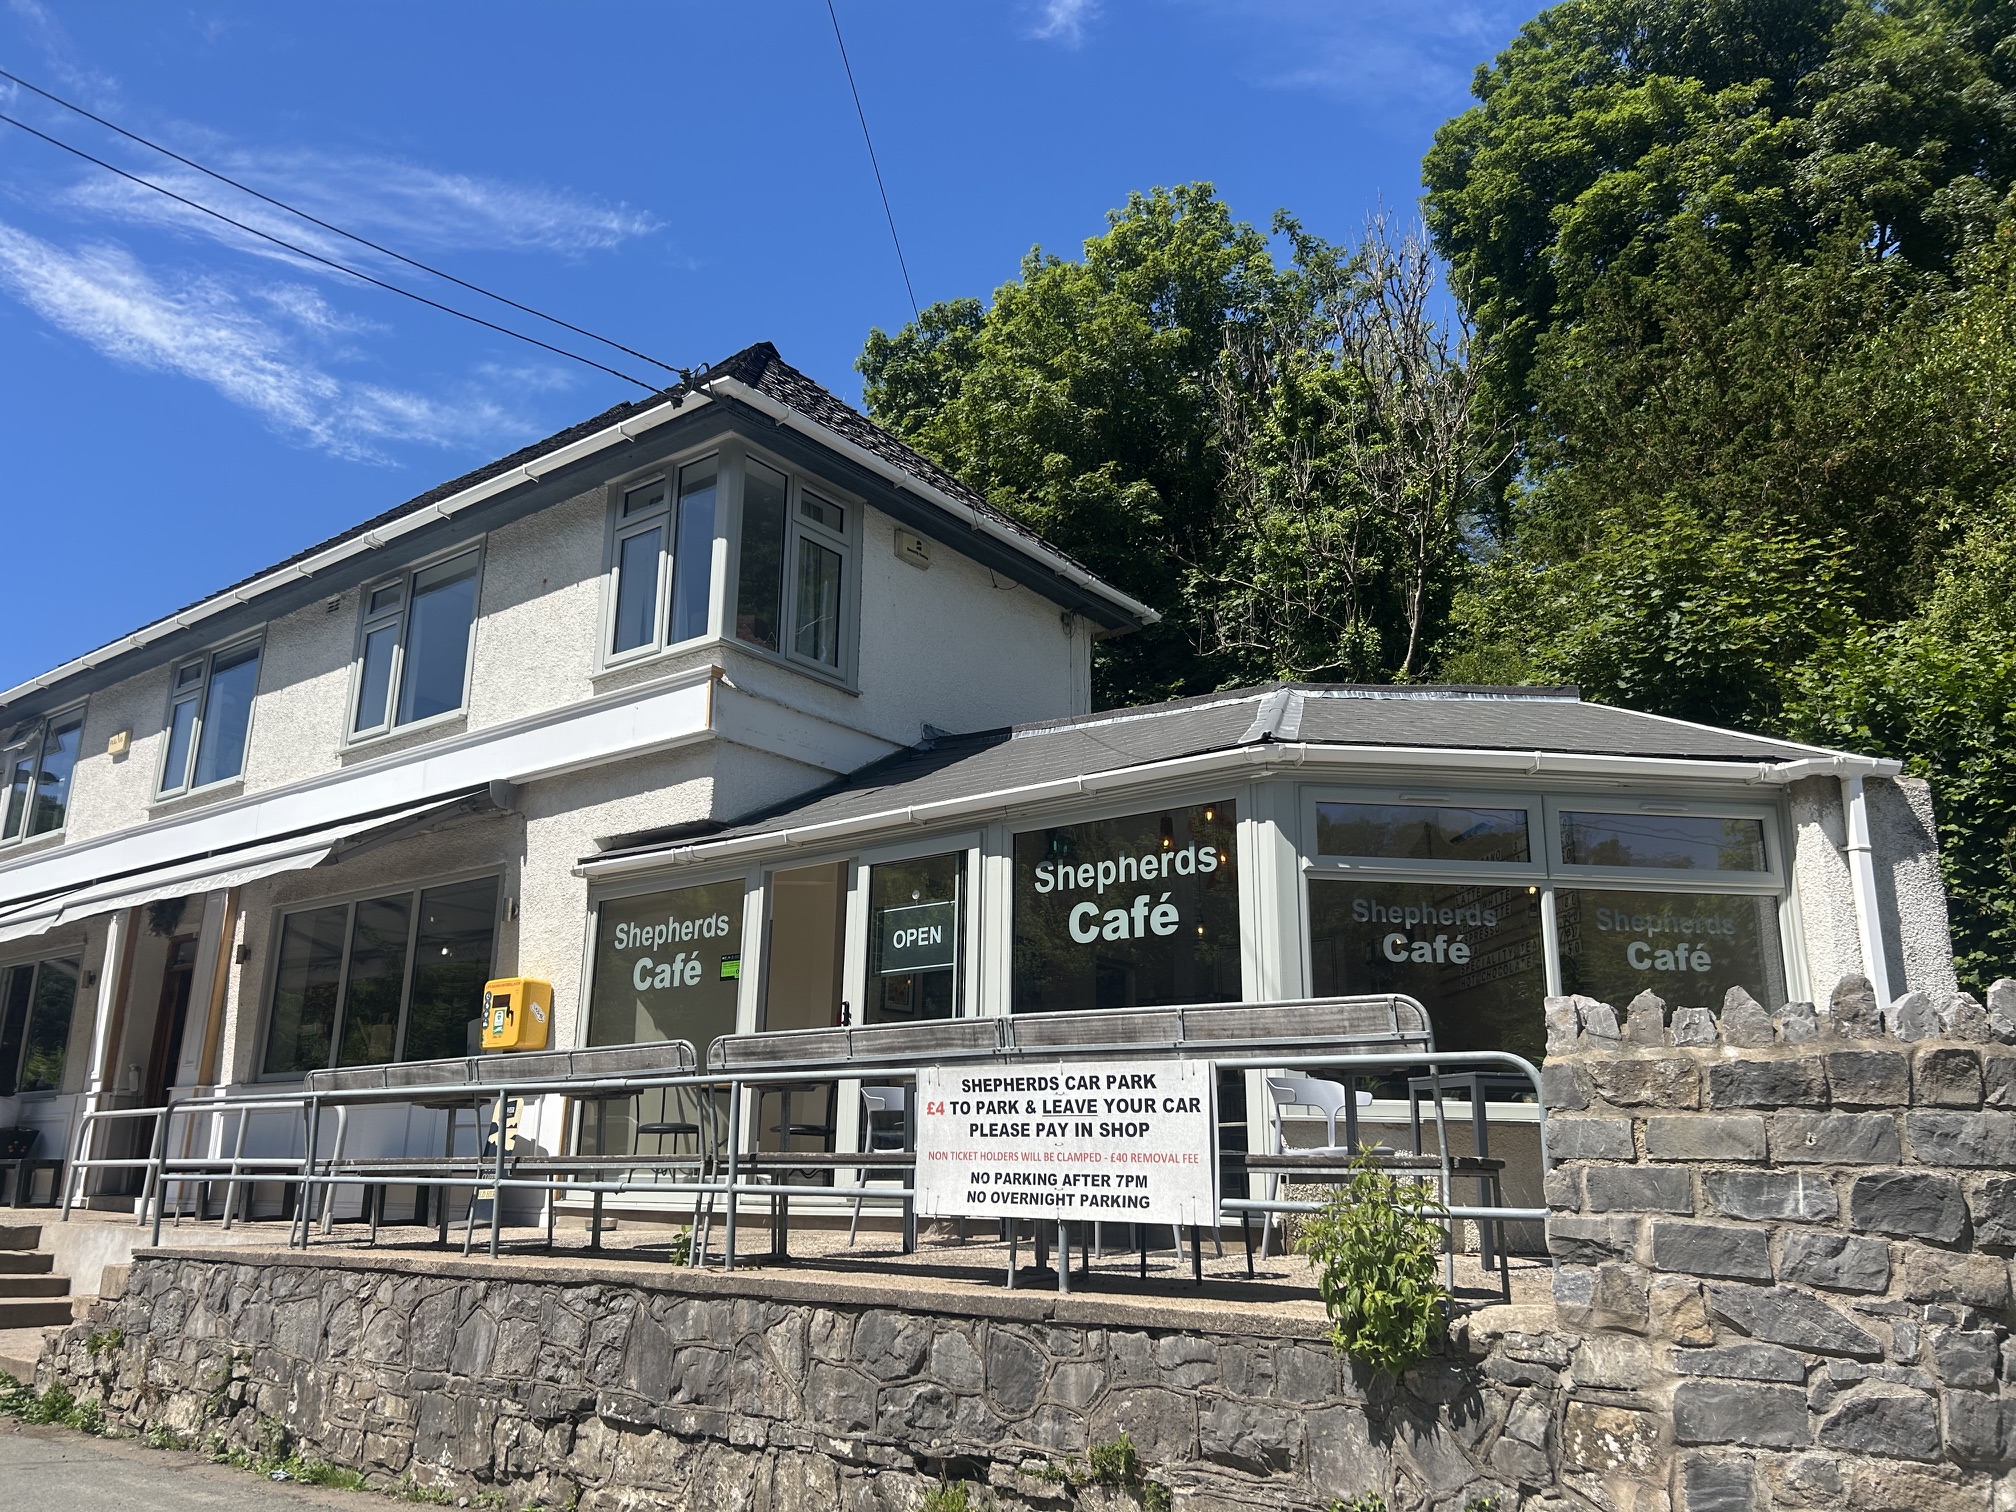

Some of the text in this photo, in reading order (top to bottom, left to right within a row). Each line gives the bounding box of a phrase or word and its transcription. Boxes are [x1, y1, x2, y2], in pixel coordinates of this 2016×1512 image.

[1034, 841, 1218, 894] Shepherds
[184, 880, 209, 895] Ice
[211, 869, 260, 889] Cream
[1456, 887, 1480, 907] LATTE
[1482, 889, 1510, 909] WHITE
[1069, 892, 1179, 944] Café
[1352, 899, 1498, 929] Shepherds
[1595, 907, 1737, 938] Shepherds
[614, 912, 729, 951] Shepherds
[893, 925, 942, 949] OPEN
[1464, 923, 1501, 945] SPRESSO
[1383, 932, 1471, 965] Café
[1460, 940, 1538, 975] SPECIALITY TEA
[1626, 941, 1711, 972] Café
[633, 951, 702, 991] Café
[1461, 956, 1532, 988] HOT CHOCOLATE
[961, 1073, 1157, 1093] SHEPHERDS CAR PARK
[926, 1097, 1201, 1116] £4 TO PARK & LEAVE YOUR CAR
[969, 1122, 1150, 1138] PLEASE PAY IN SHOP
[928, 1151, 948, 1161] NON
[951, 1151, 978, 1161] TICKET
[980, 1151, 1019, 1161] HOLDERS
[1020, 1152, 1041, 1162] WILL
[1043, 1152, 1055, 1162] BE
[1057, 1152, 1102, 1163] CLAMPED
[1110, 1153, 1128, 1163] £40
[1130, 1153, 1180, 1164] REMOVAL
[1182, 1153, 1199, 1164] FEE
[970, 1171, 1148, 1189] NO PARKING AFTER 7PM
[966, 1190, 1150, 1209] NO OVERNIGHT PARKING
